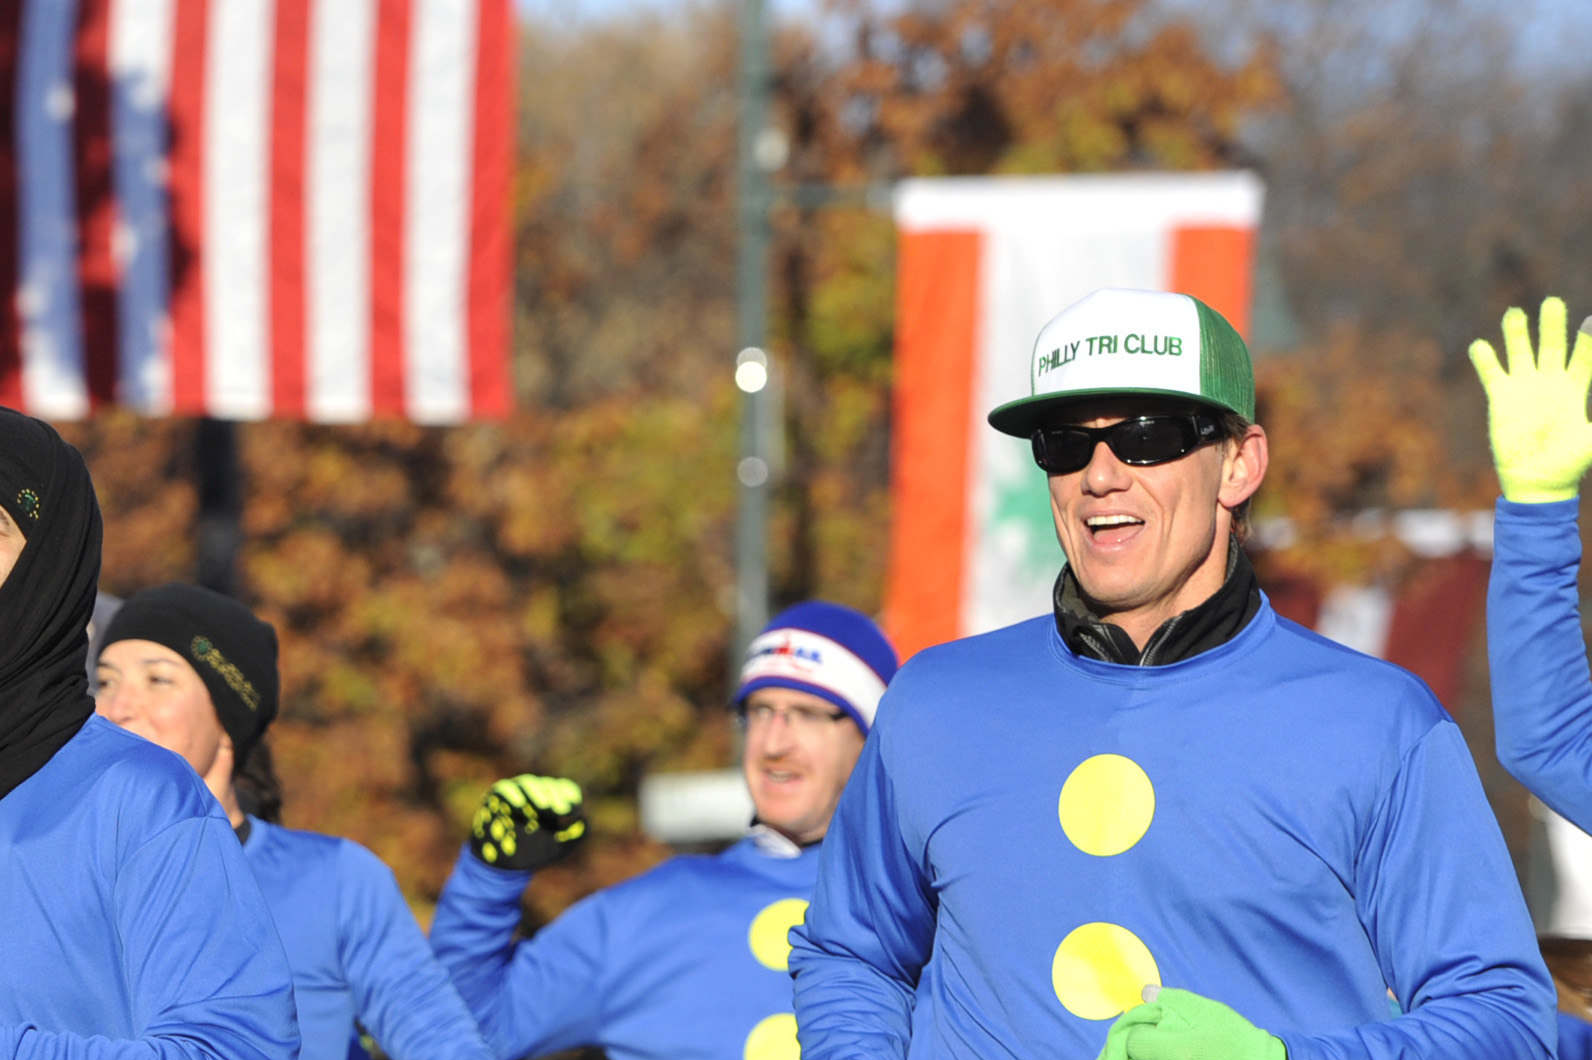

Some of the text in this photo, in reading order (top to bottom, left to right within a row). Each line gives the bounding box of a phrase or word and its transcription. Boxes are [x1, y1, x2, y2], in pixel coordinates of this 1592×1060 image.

[1037, 333, 1183, 377] PHILLY TRI CLUB
